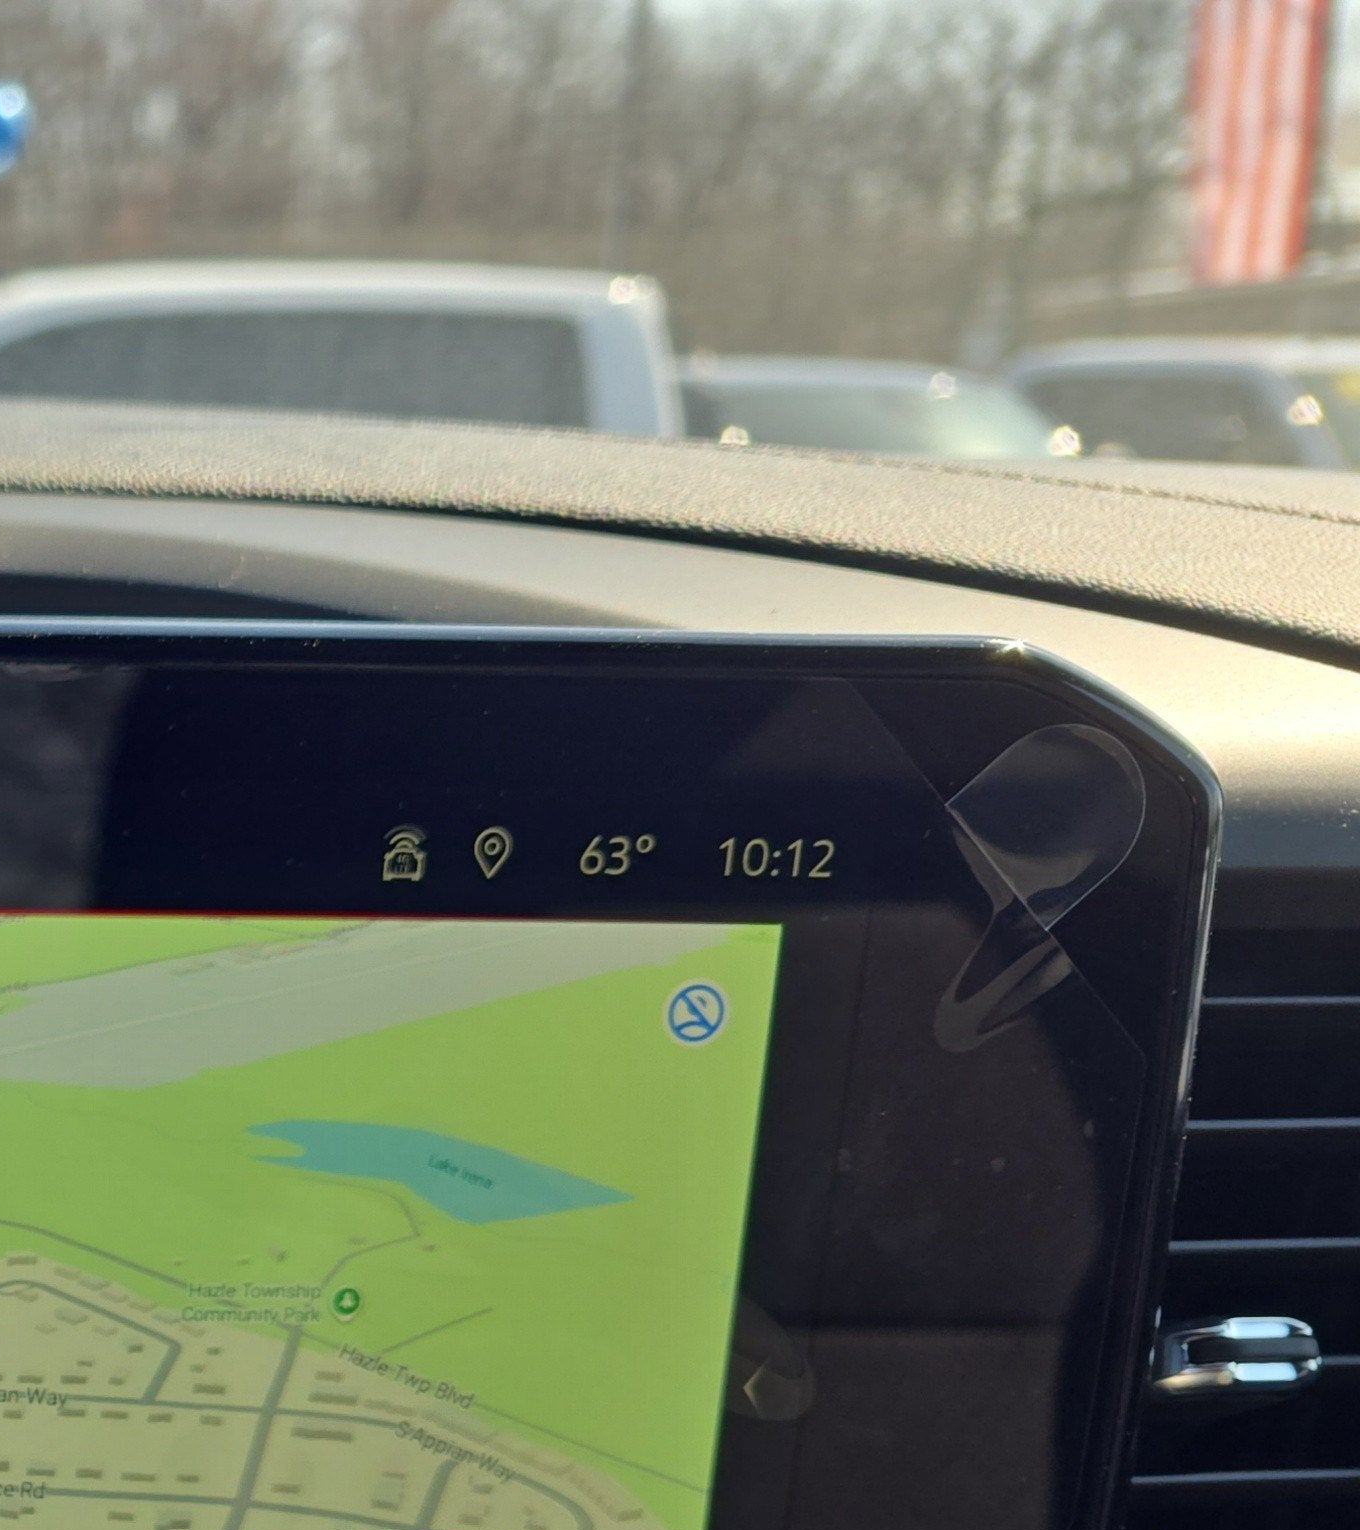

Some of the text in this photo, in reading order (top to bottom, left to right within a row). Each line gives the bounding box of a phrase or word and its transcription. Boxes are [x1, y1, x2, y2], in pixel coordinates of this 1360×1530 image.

[718, 837, 836, 879] 10:12
[242, 1282, 322, 1299] Township
[181, 1306, 321, 1324] Community Park
[338, 1343, 476, 1410] Hazle Twp Blvd
[25, 1388, 69, 1409] Way
[394, 1421, 515, 1483] S Appian Way
[19, 1481, 46, 1500] Rd
